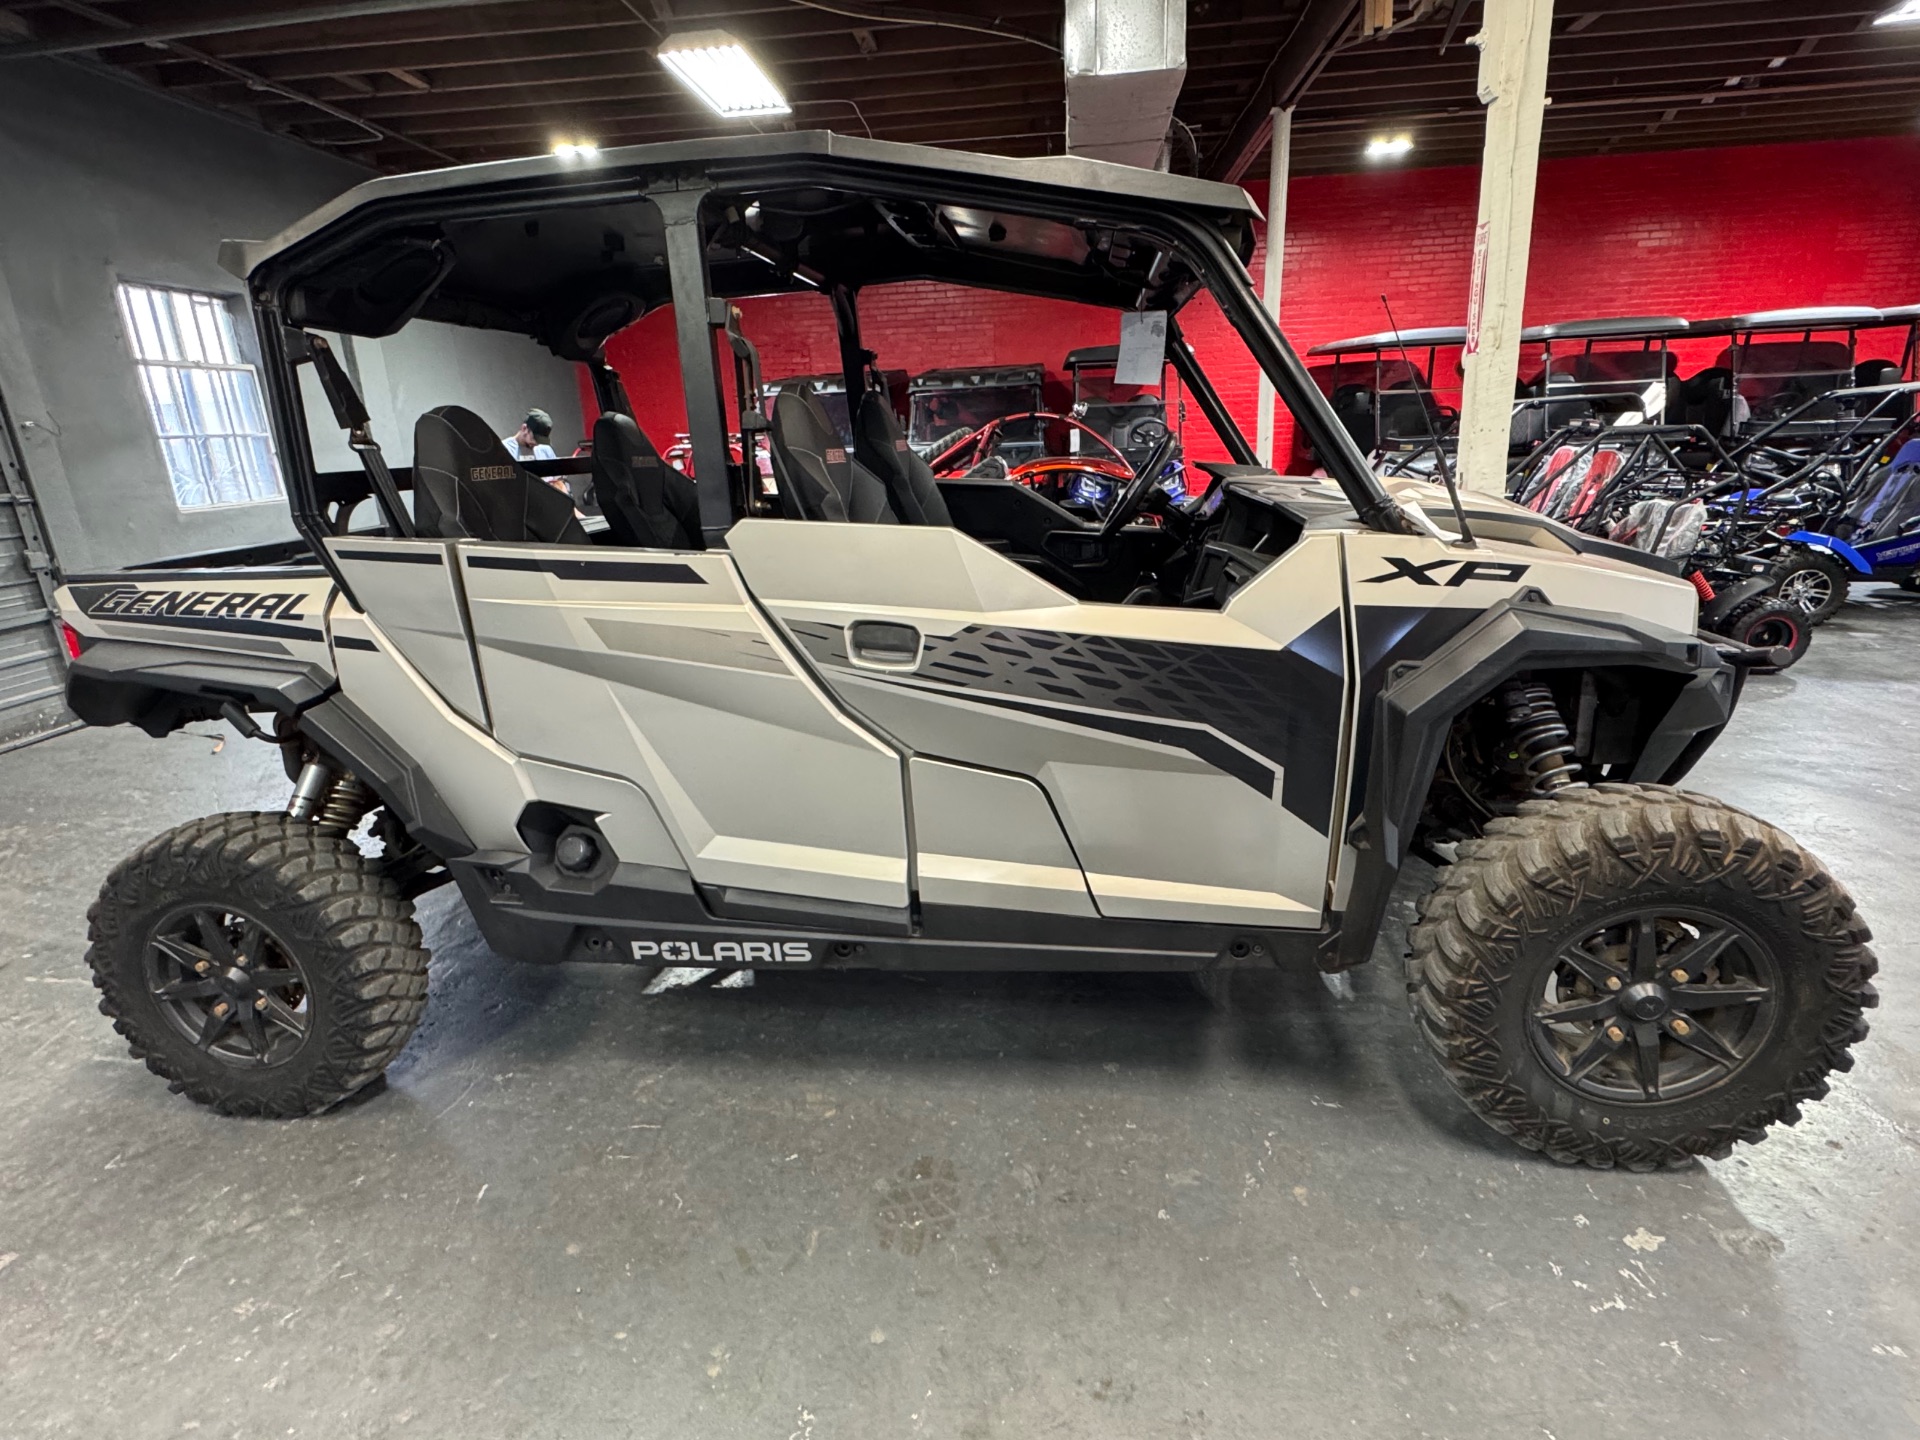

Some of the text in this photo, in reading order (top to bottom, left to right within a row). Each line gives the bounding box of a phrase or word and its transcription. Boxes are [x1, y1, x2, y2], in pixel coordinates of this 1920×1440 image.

[1471, 249, 1482, 343] EXTINGUISHER
[471, 466, 517, 482] GENERAL
[1356, 557, 1531, 587] XP
[88, 589, 310, 621] GENERAL
[631, 941, 812, 962] POLARIS
